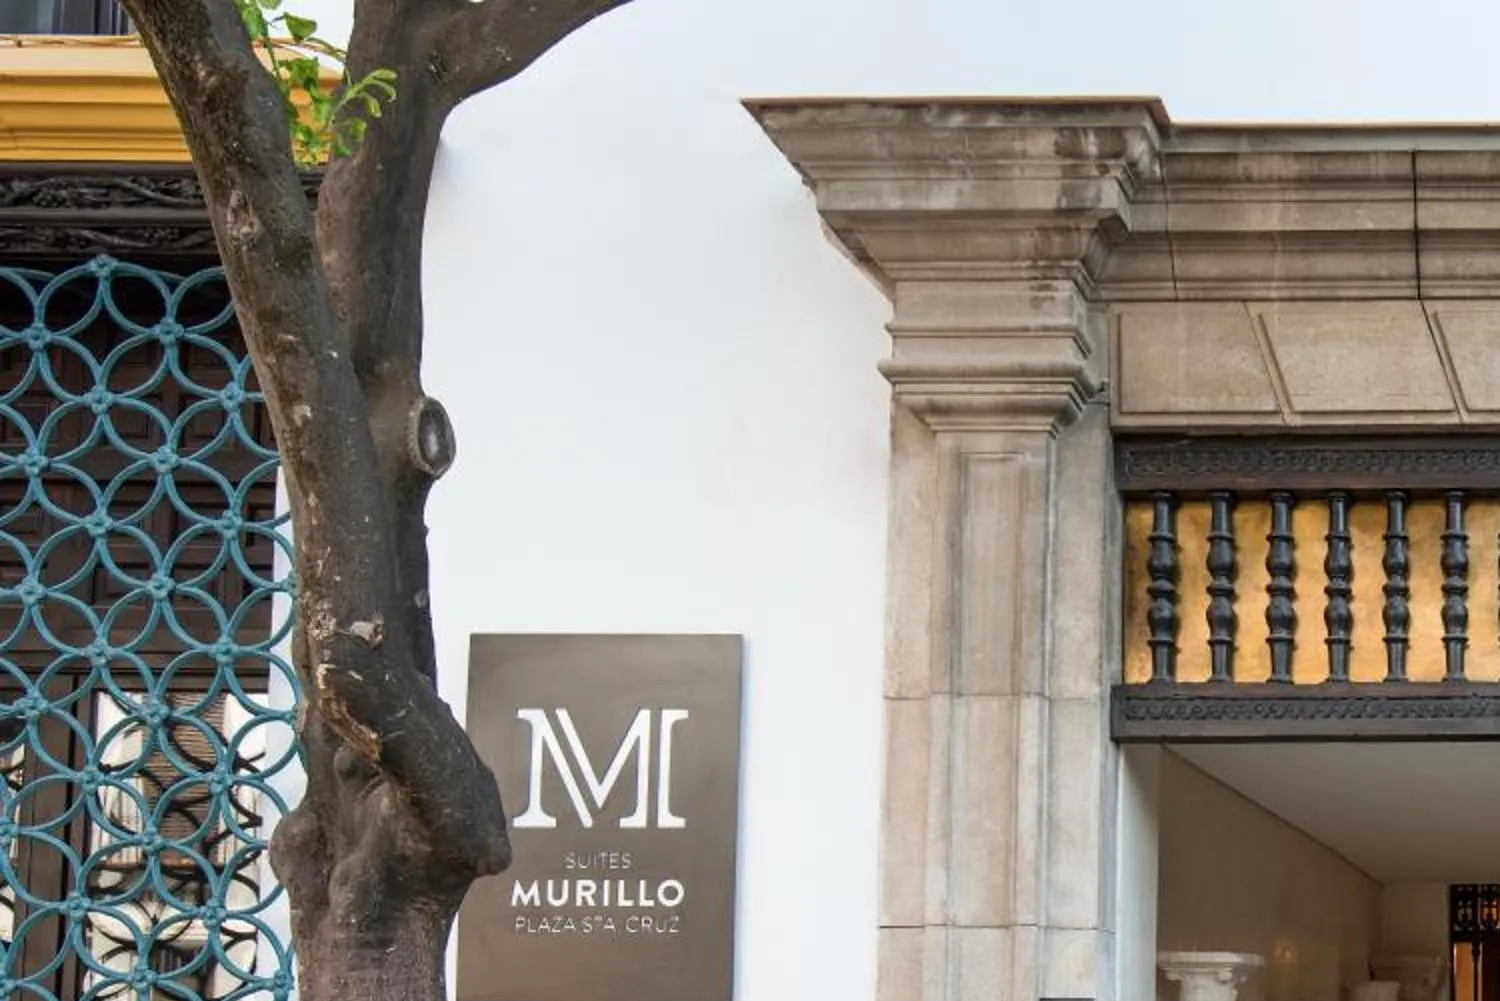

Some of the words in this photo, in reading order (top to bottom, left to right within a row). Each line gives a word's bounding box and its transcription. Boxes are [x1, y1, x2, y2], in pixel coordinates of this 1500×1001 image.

[565, 852, 632, 869] SUITES
[511, 879, 685, 907] MURILLO
[515, 916, 576, 933] PLAZA
[625, 916, 680, 933] CRUZ
